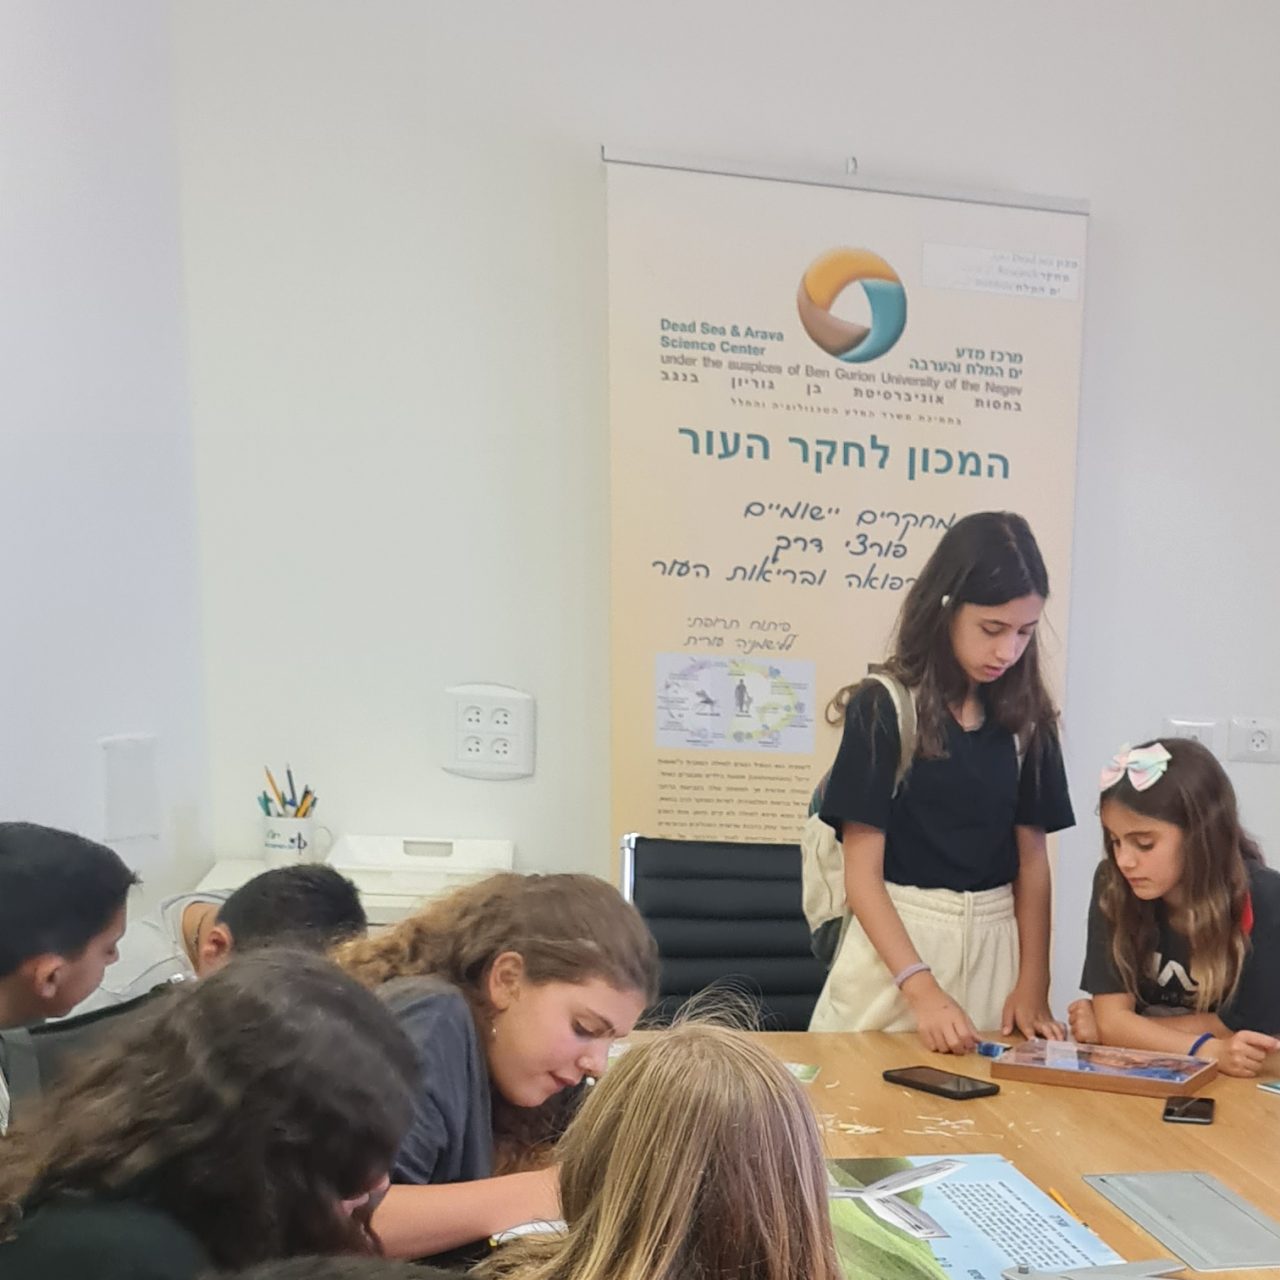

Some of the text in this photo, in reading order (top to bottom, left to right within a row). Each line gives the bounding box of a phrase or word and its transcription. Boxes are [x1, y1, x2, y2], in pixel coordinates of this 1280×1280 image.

[661, 319, 784, 342] Dead Sea & Arava
[661, 337, 766, 356] Science Center
[956, 347, 1023, 364] מרכז מדע
[661, 354, 1023, 398] under the auspices of Ben Gurion University of the Negev
[909, 358, 1023, 379] ים המלח והערבה
[660, 371, 1022, 412] בחסות אוניברסיטת בן גוריון בנגב
[678, 427, 1010, 481] המכון לחקר העור
[744, 501, 956, 541] מחקרים יישומיים
[772, 534, 908, 564] פורצי דרך
[652, 560, 710, 578] העור
[726, 555, 826, 586] ובריאות
[750, 619, 792, 632] פיתוח
